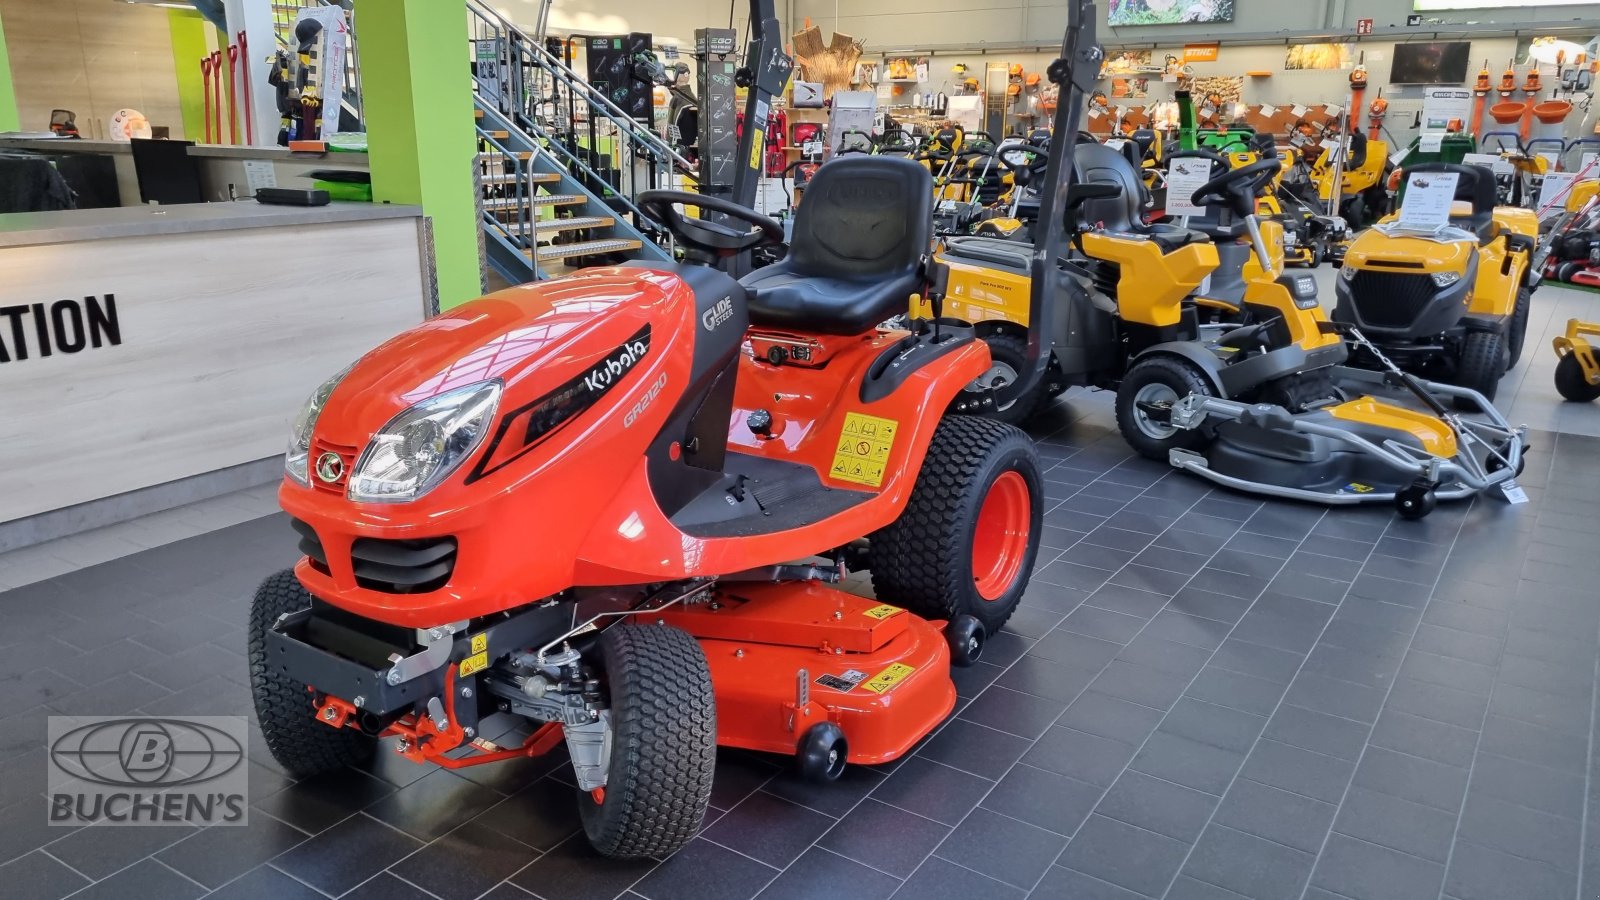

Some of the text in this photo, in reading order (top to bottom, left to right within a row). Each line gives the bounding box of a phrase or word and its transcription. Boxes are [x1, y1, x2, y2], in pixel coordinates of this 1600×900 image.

[702, 296, 732, 331] GLIDE
[715, 309, 733, 326] STEER
[584, 340, 647, 392] Kubota
[623, 372, 668, 429] GR2120
